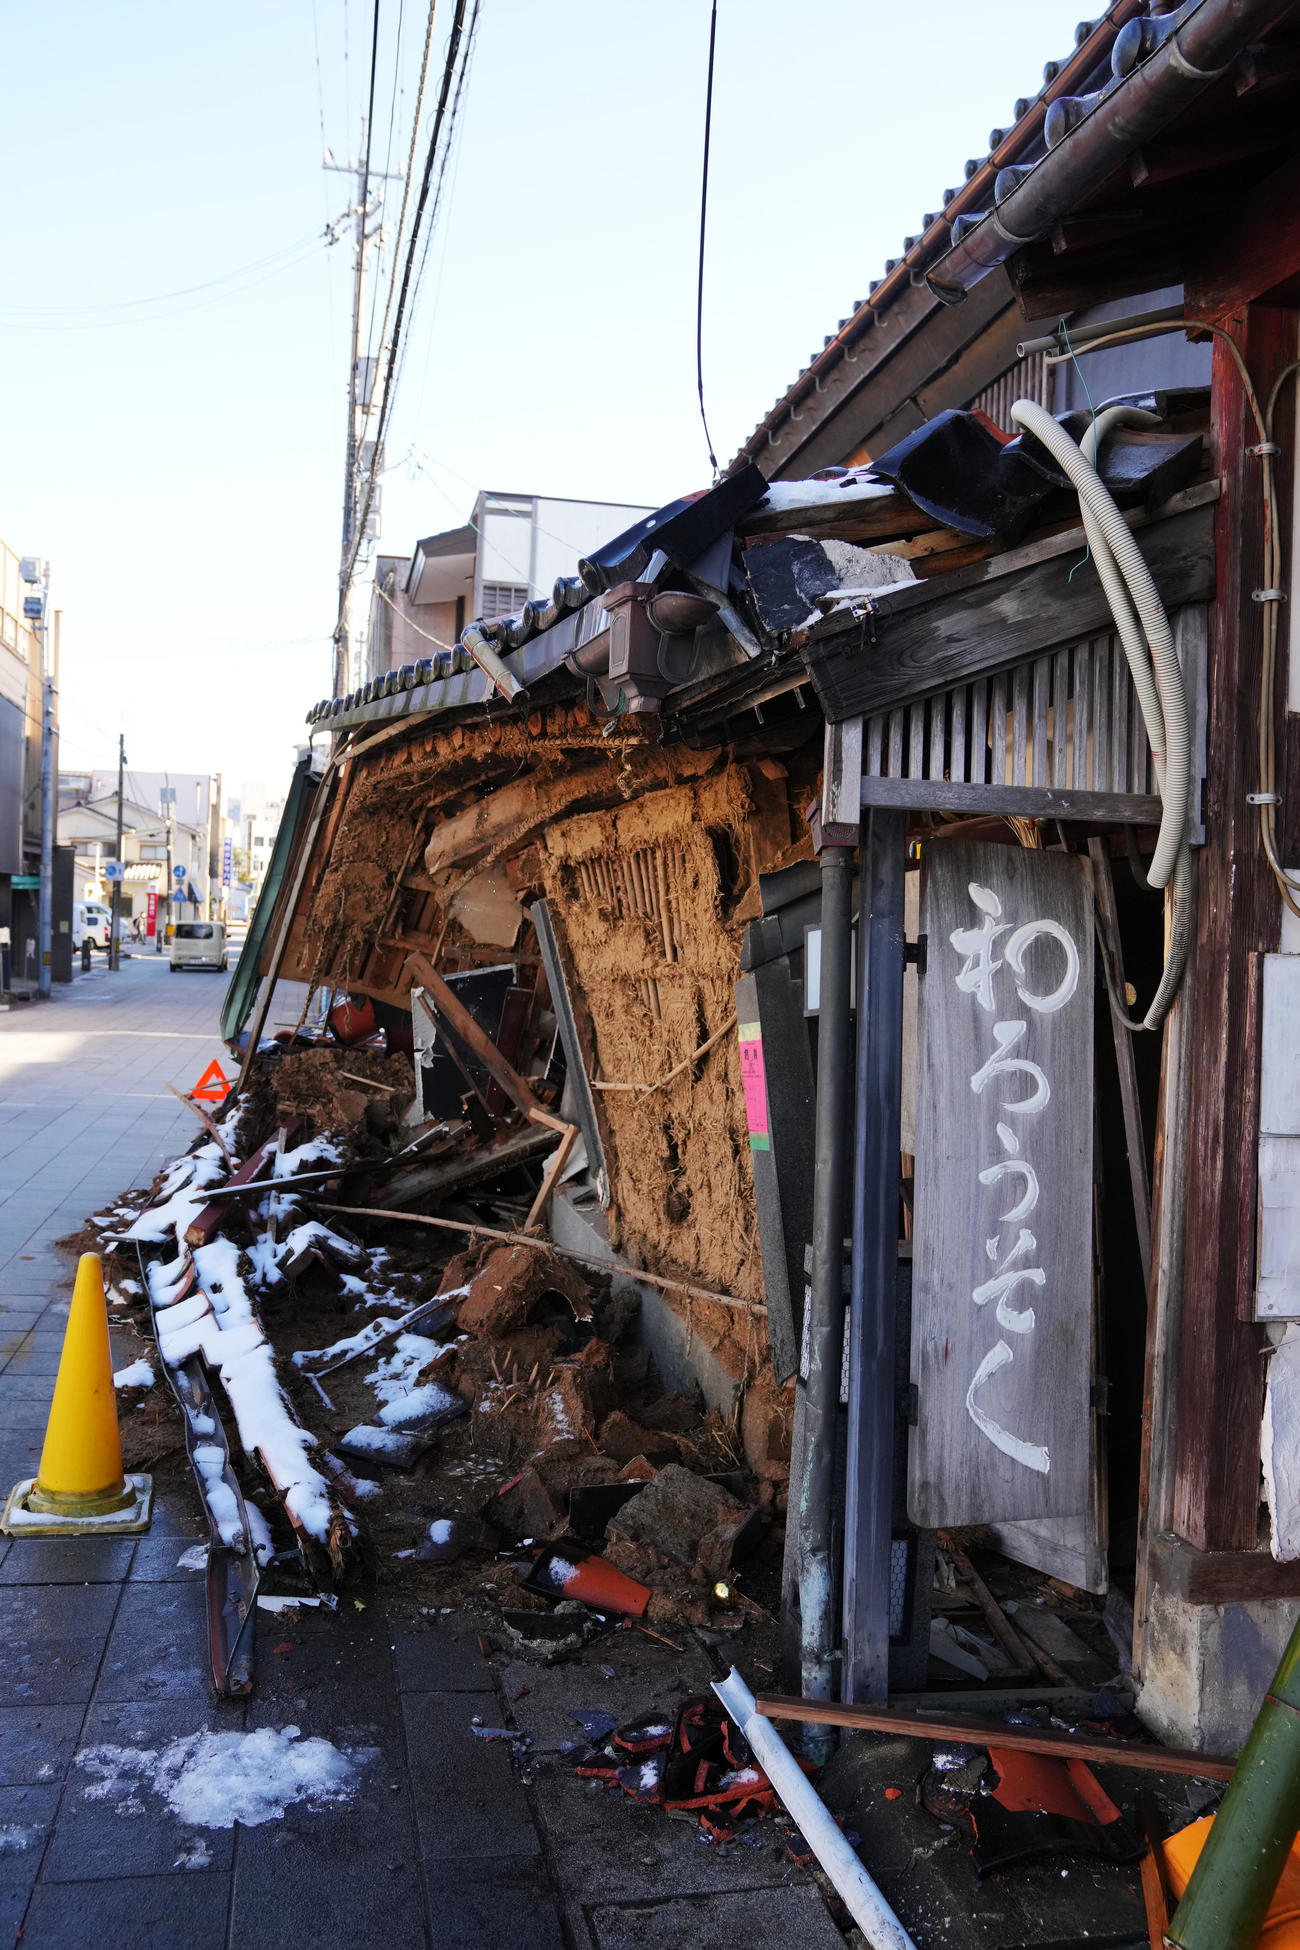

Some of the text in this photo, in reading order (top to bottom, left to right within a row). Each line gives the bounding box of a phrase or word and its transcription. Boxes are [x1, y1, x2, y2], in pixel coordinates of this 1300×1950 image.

[950, 882, 1080, 1474] 和ろうそく
